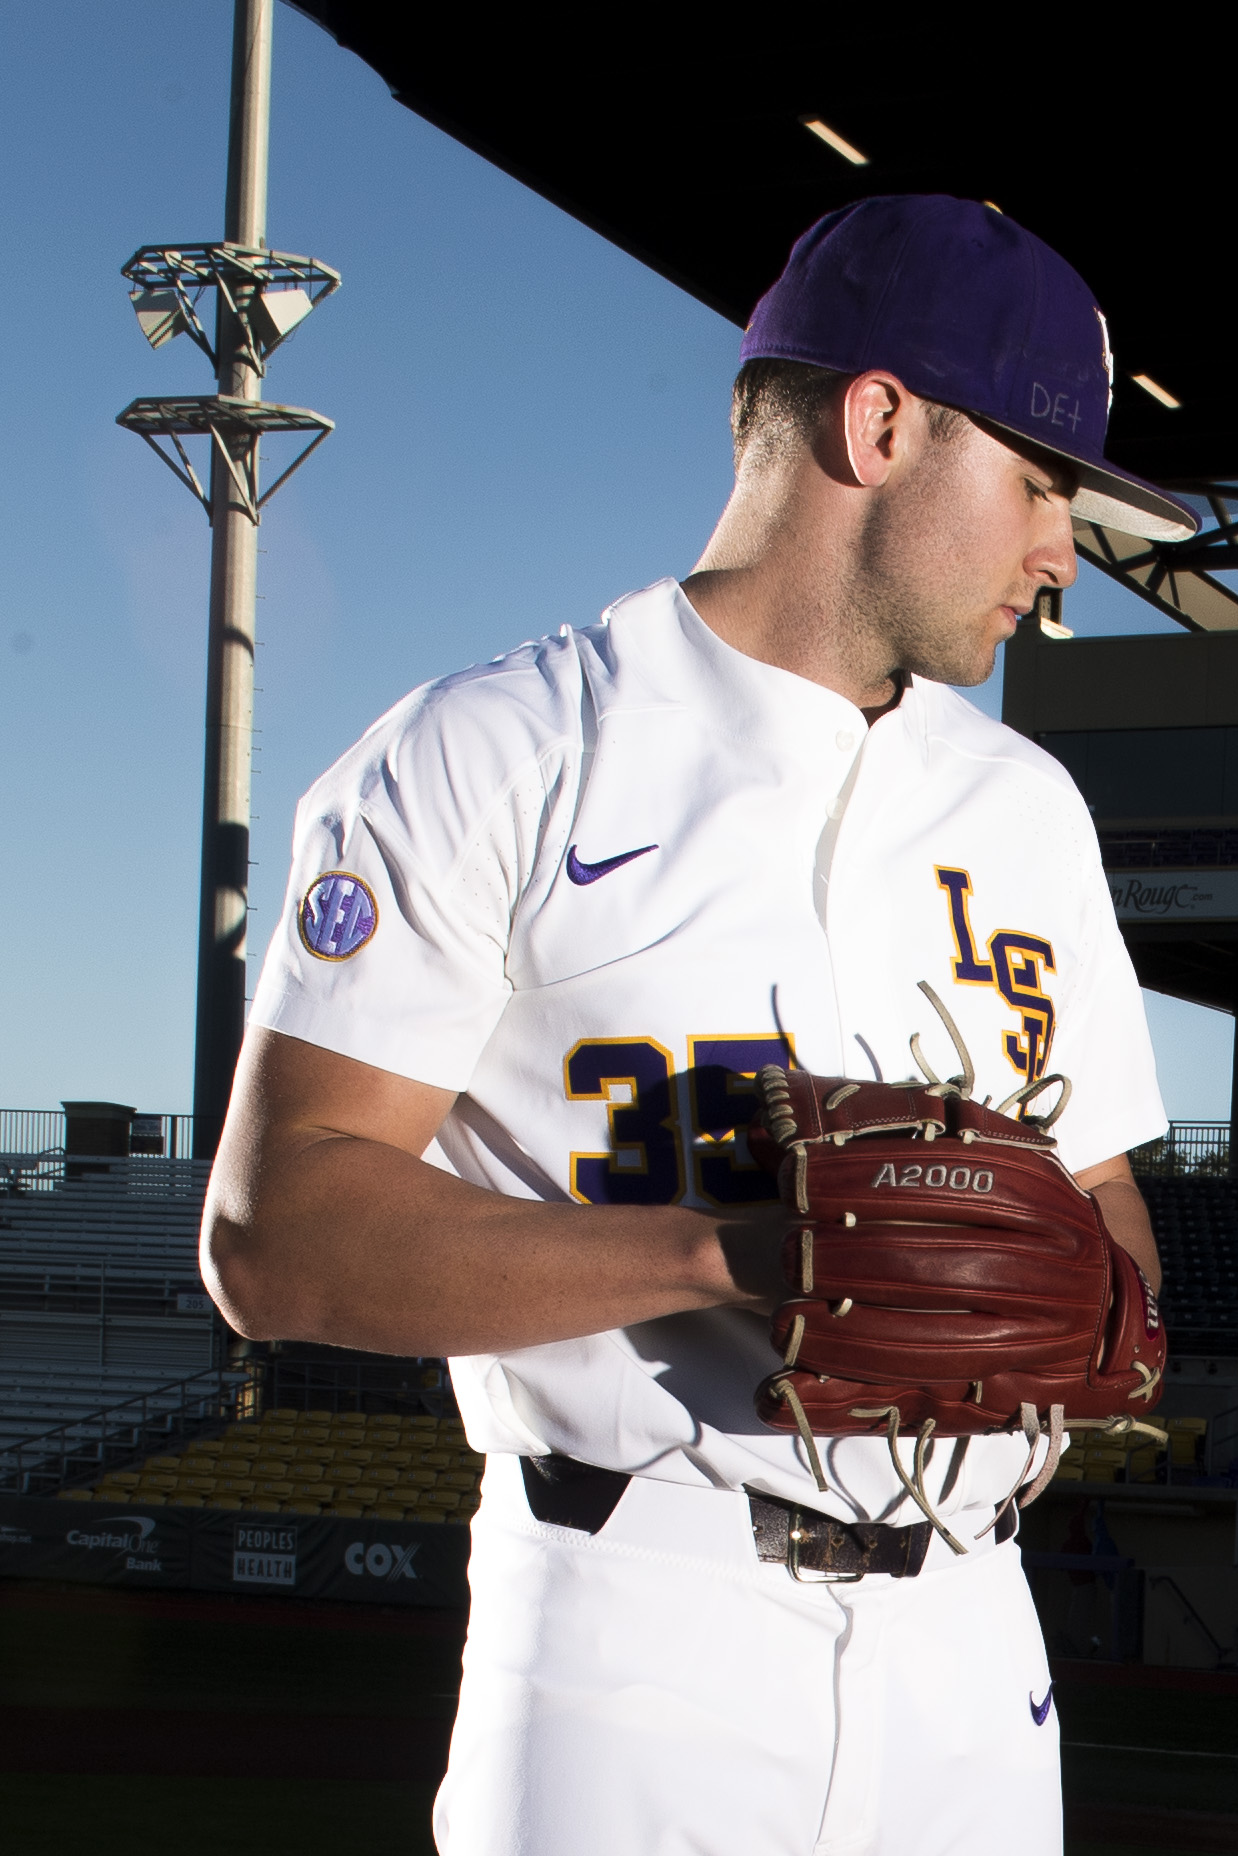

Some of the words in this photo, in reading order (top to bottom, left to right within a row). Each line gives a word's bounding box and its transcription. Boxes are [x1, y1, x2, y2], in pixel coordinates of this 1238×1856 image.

[563, 1033, 796, 1209] 35
[871, 1163, 994, 1193] A2000
[238, 1529, 294, 1550] PEOPLES
[125, 1556, 163, 1572] Bank
[236, 1557, 293, 1579] HEALTH
[344, 1541, 422, 1583] COX
